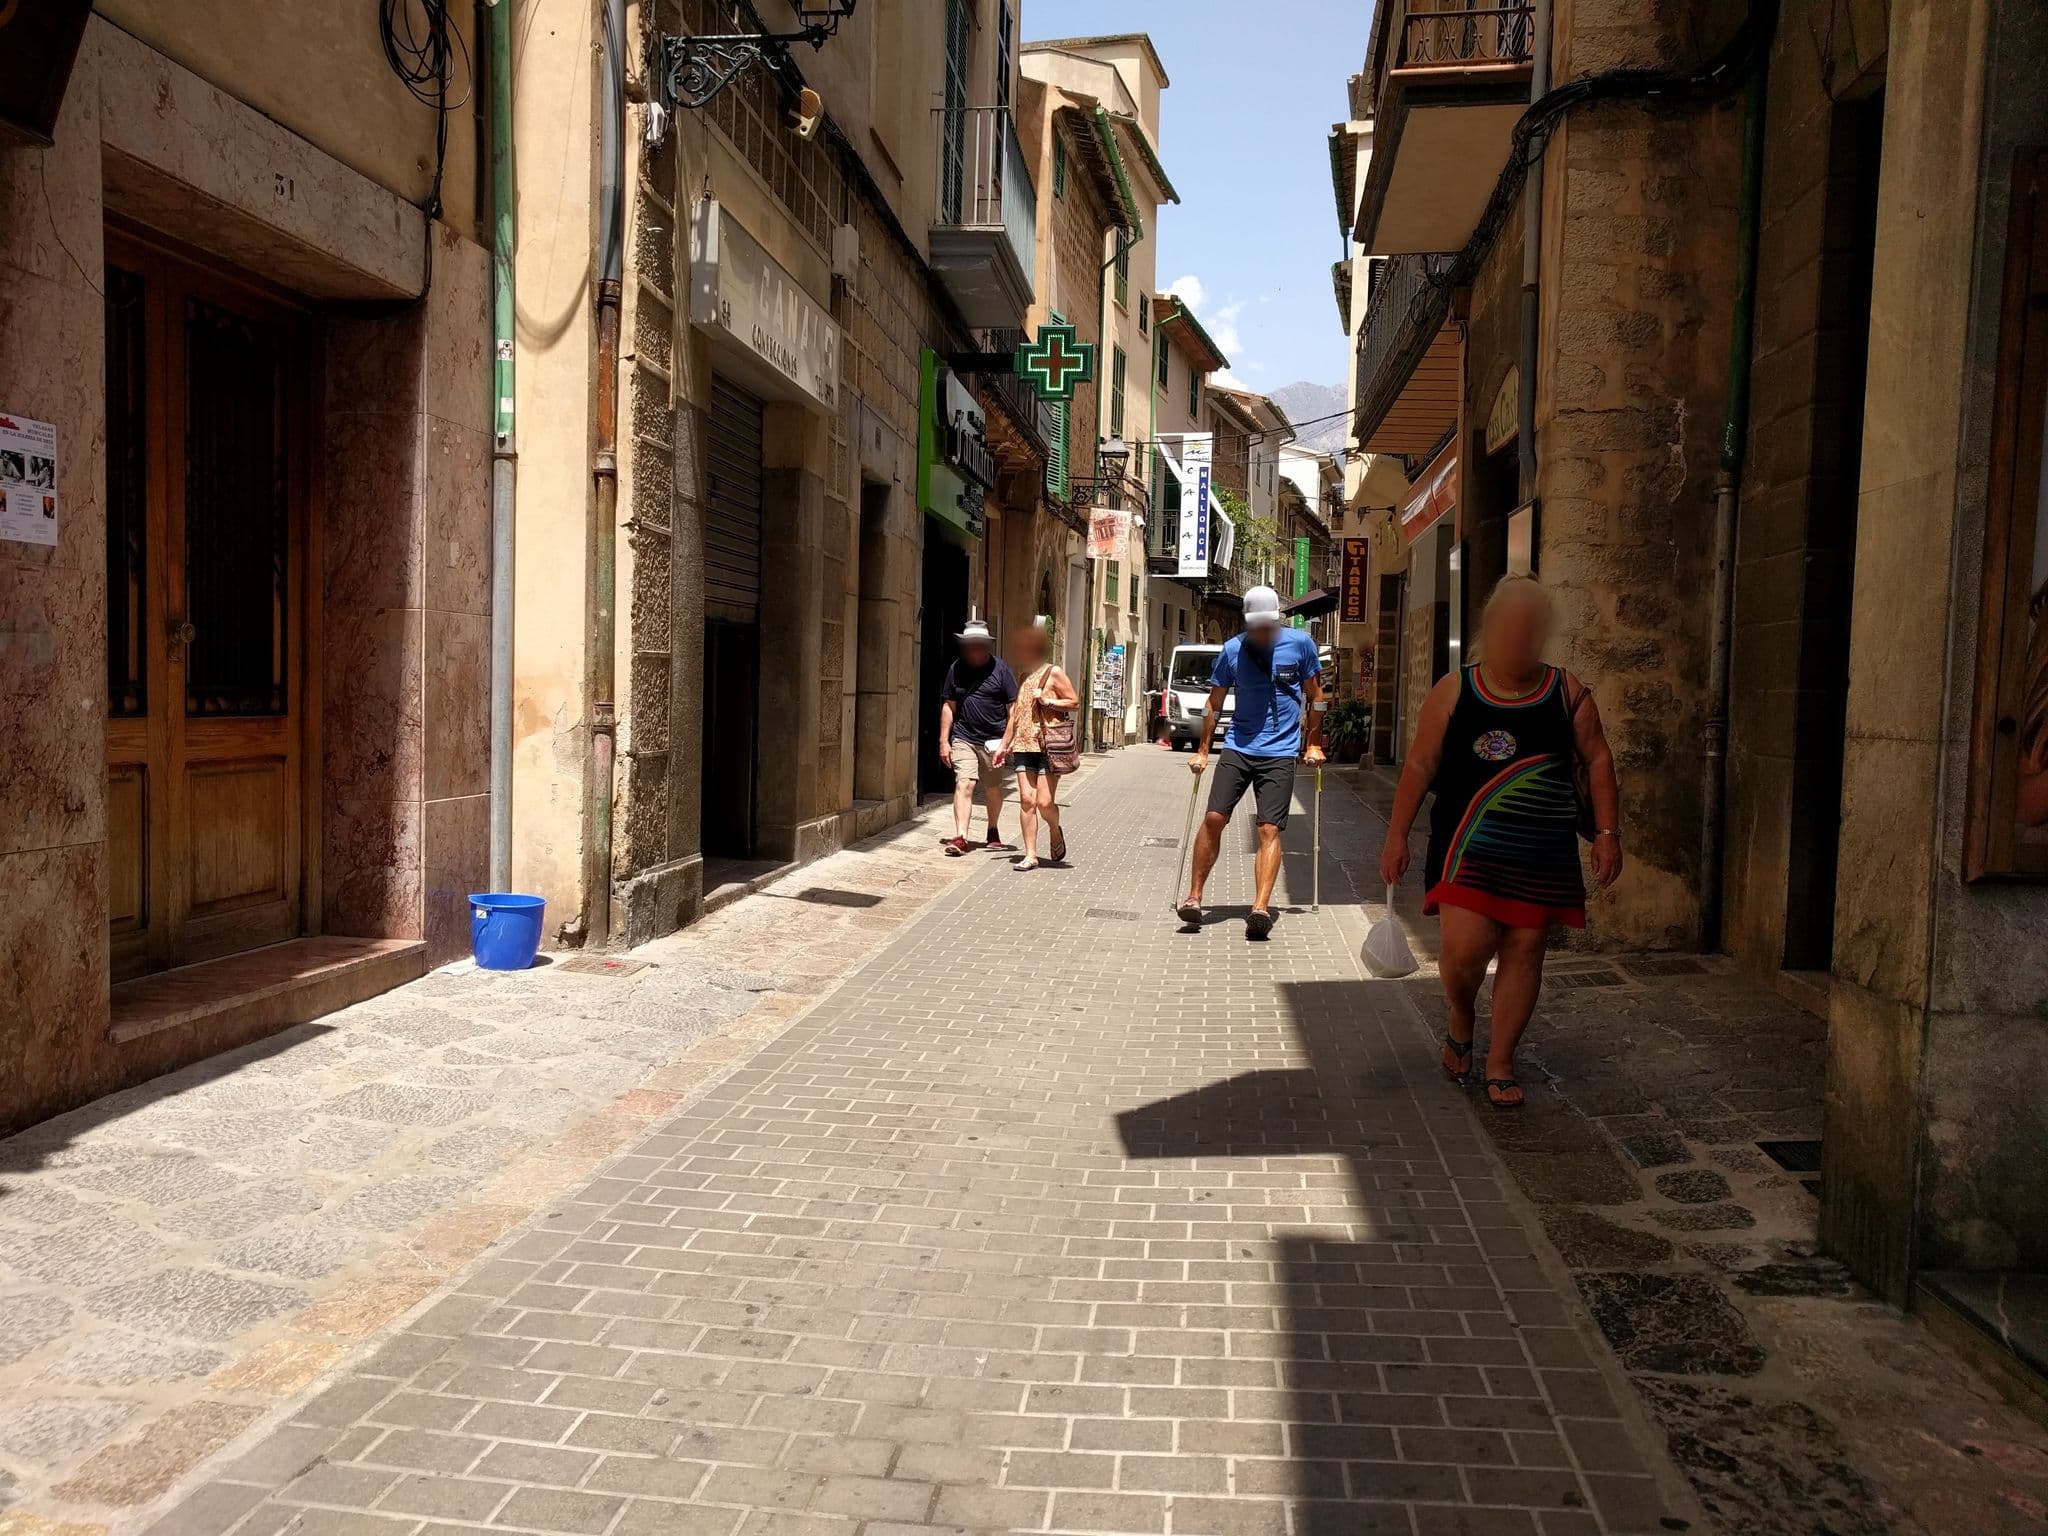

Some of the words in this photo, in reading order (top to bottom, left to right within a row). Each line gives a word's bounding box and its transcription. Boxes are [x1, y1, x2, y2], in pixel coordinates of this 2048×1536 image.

[274, 172, 296, 202] 31
[1198, 471, 1208, 556] MALLORCA
[1347, 556, 1361, 616] TABACS
